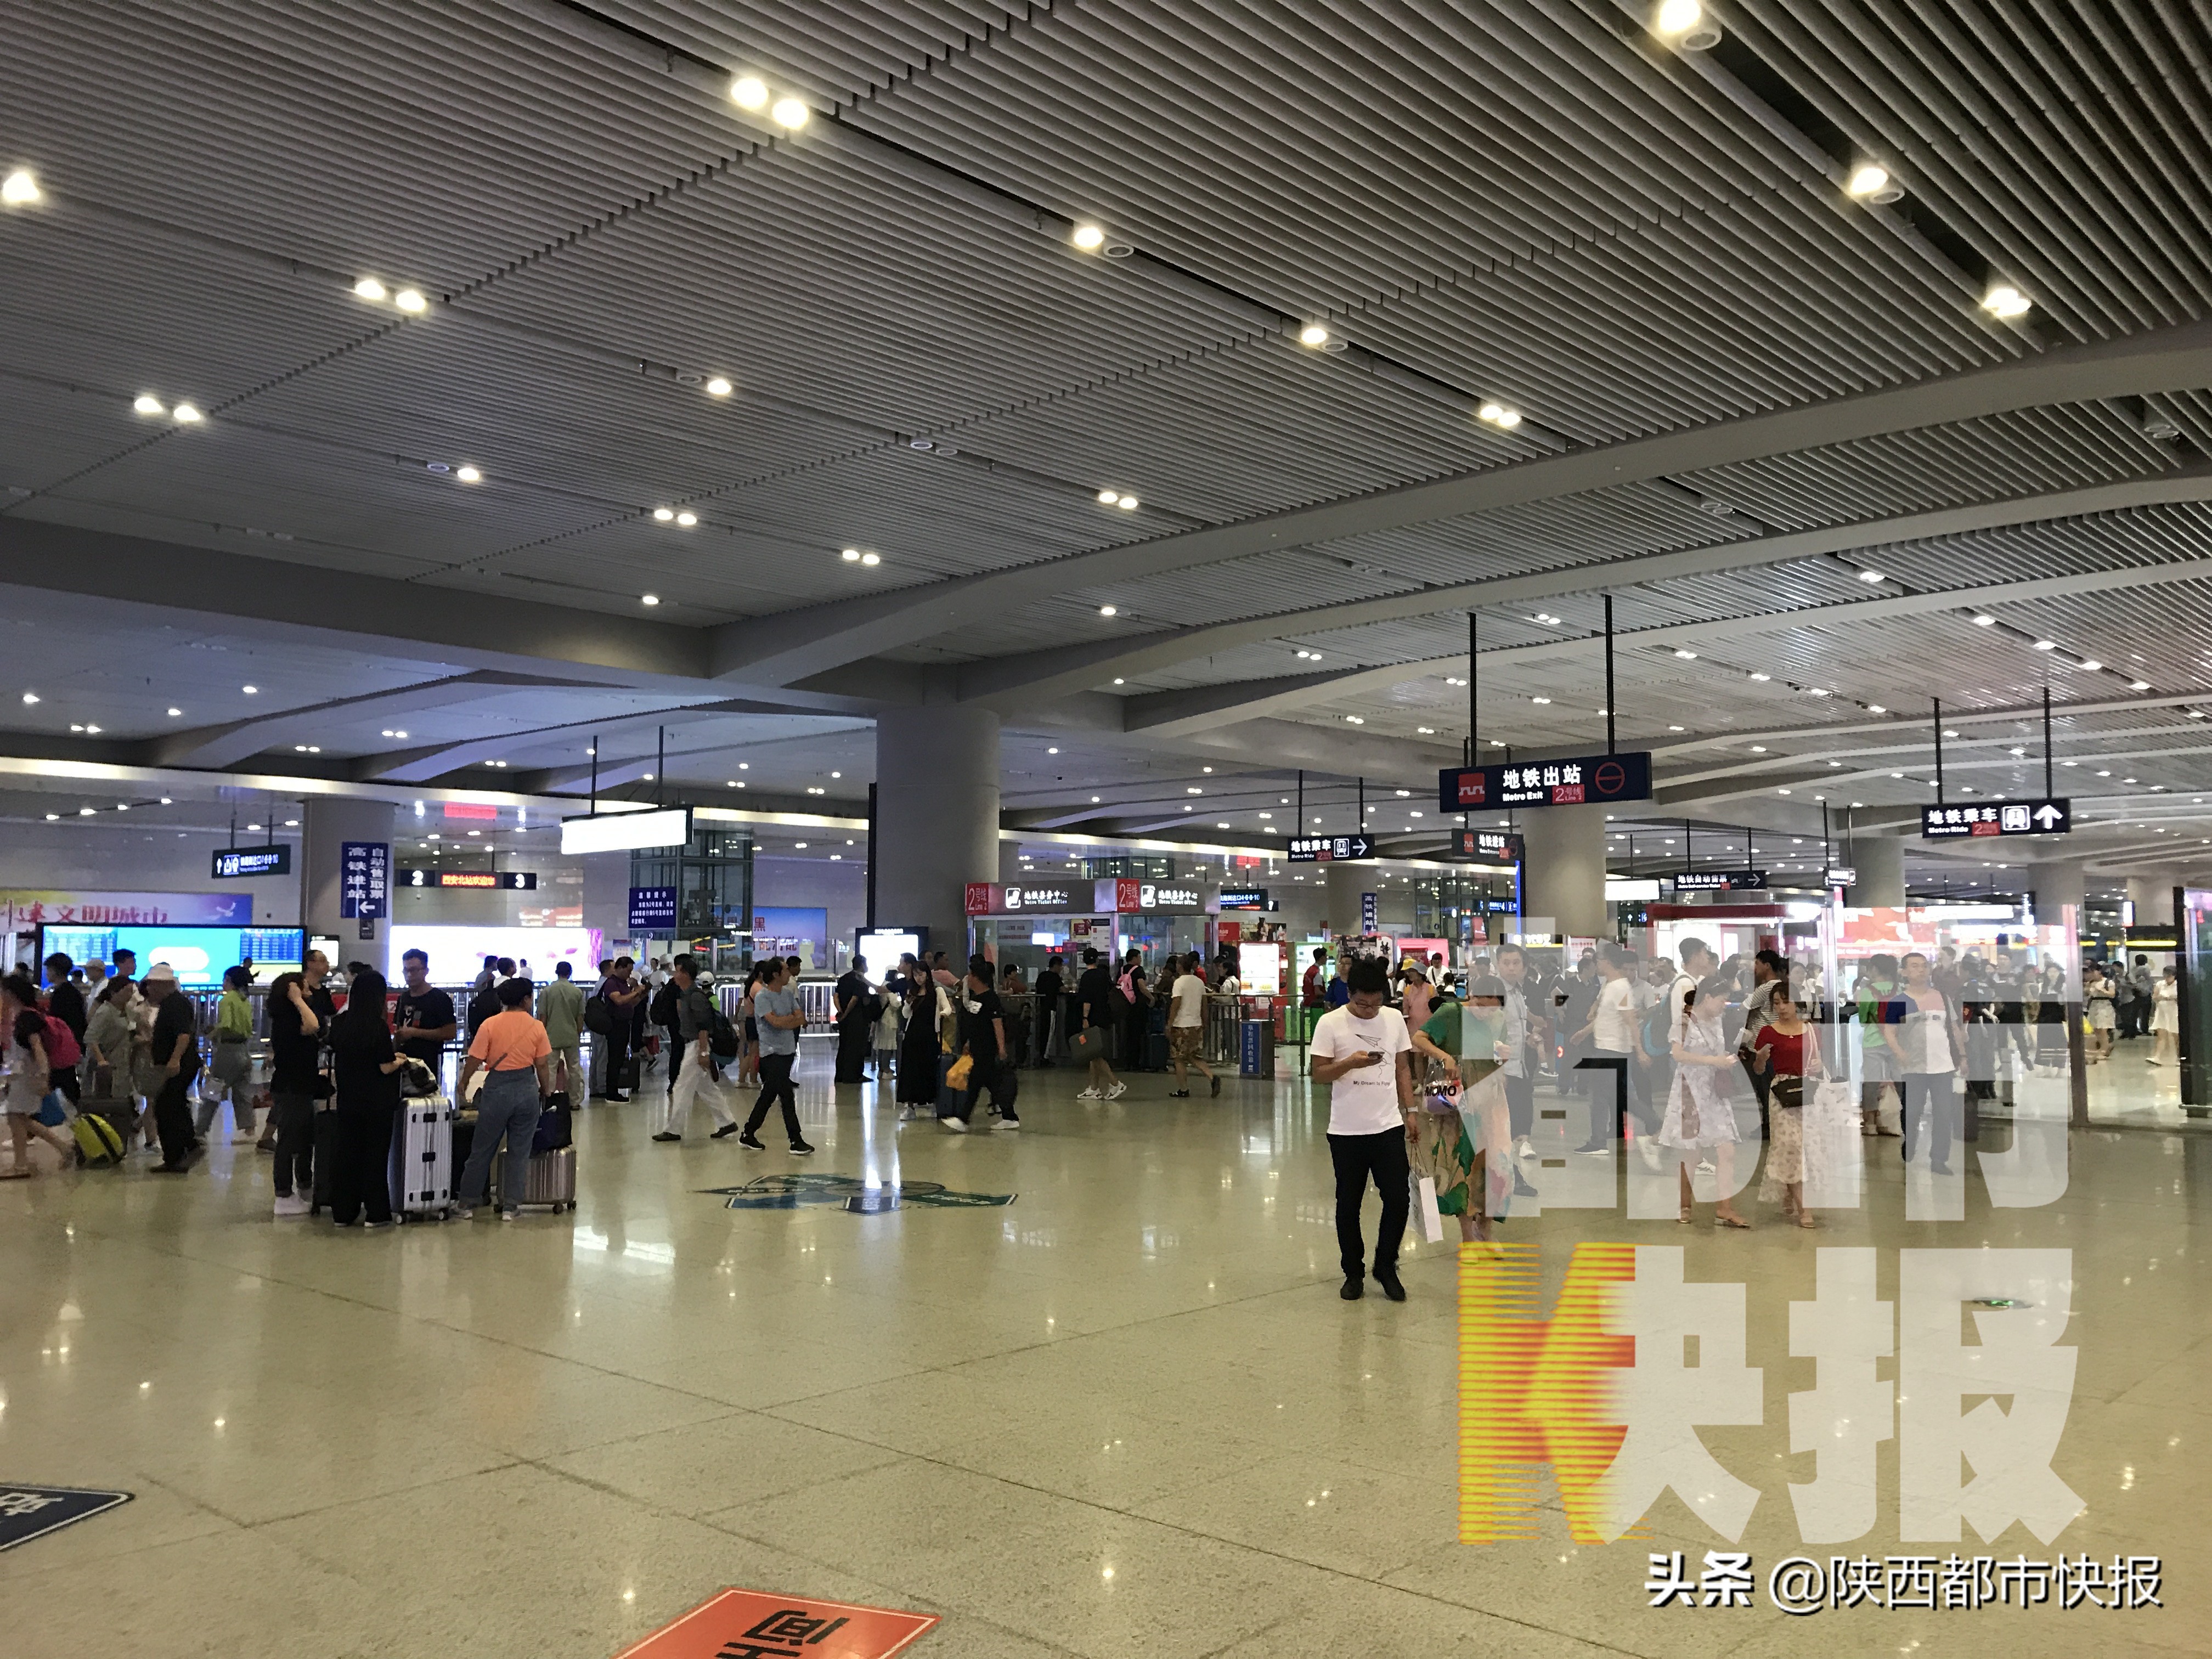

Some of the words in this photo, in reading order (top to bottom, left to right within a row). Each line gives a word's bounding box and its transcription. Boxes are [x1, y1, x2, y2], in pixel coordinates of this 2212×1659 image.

[1503, 764, 1581, 789] 地铁出站
[1503, 793, 1525, 802] Metro
[1527, 791, 1543, 800] Exit
[1928, 808, 1997, 824] 地铁乘车
[1291, 839, 1331, 852] 地铁乘车
[411, 870, 424, 885] 2
[515, 874, 525, 888] 3
